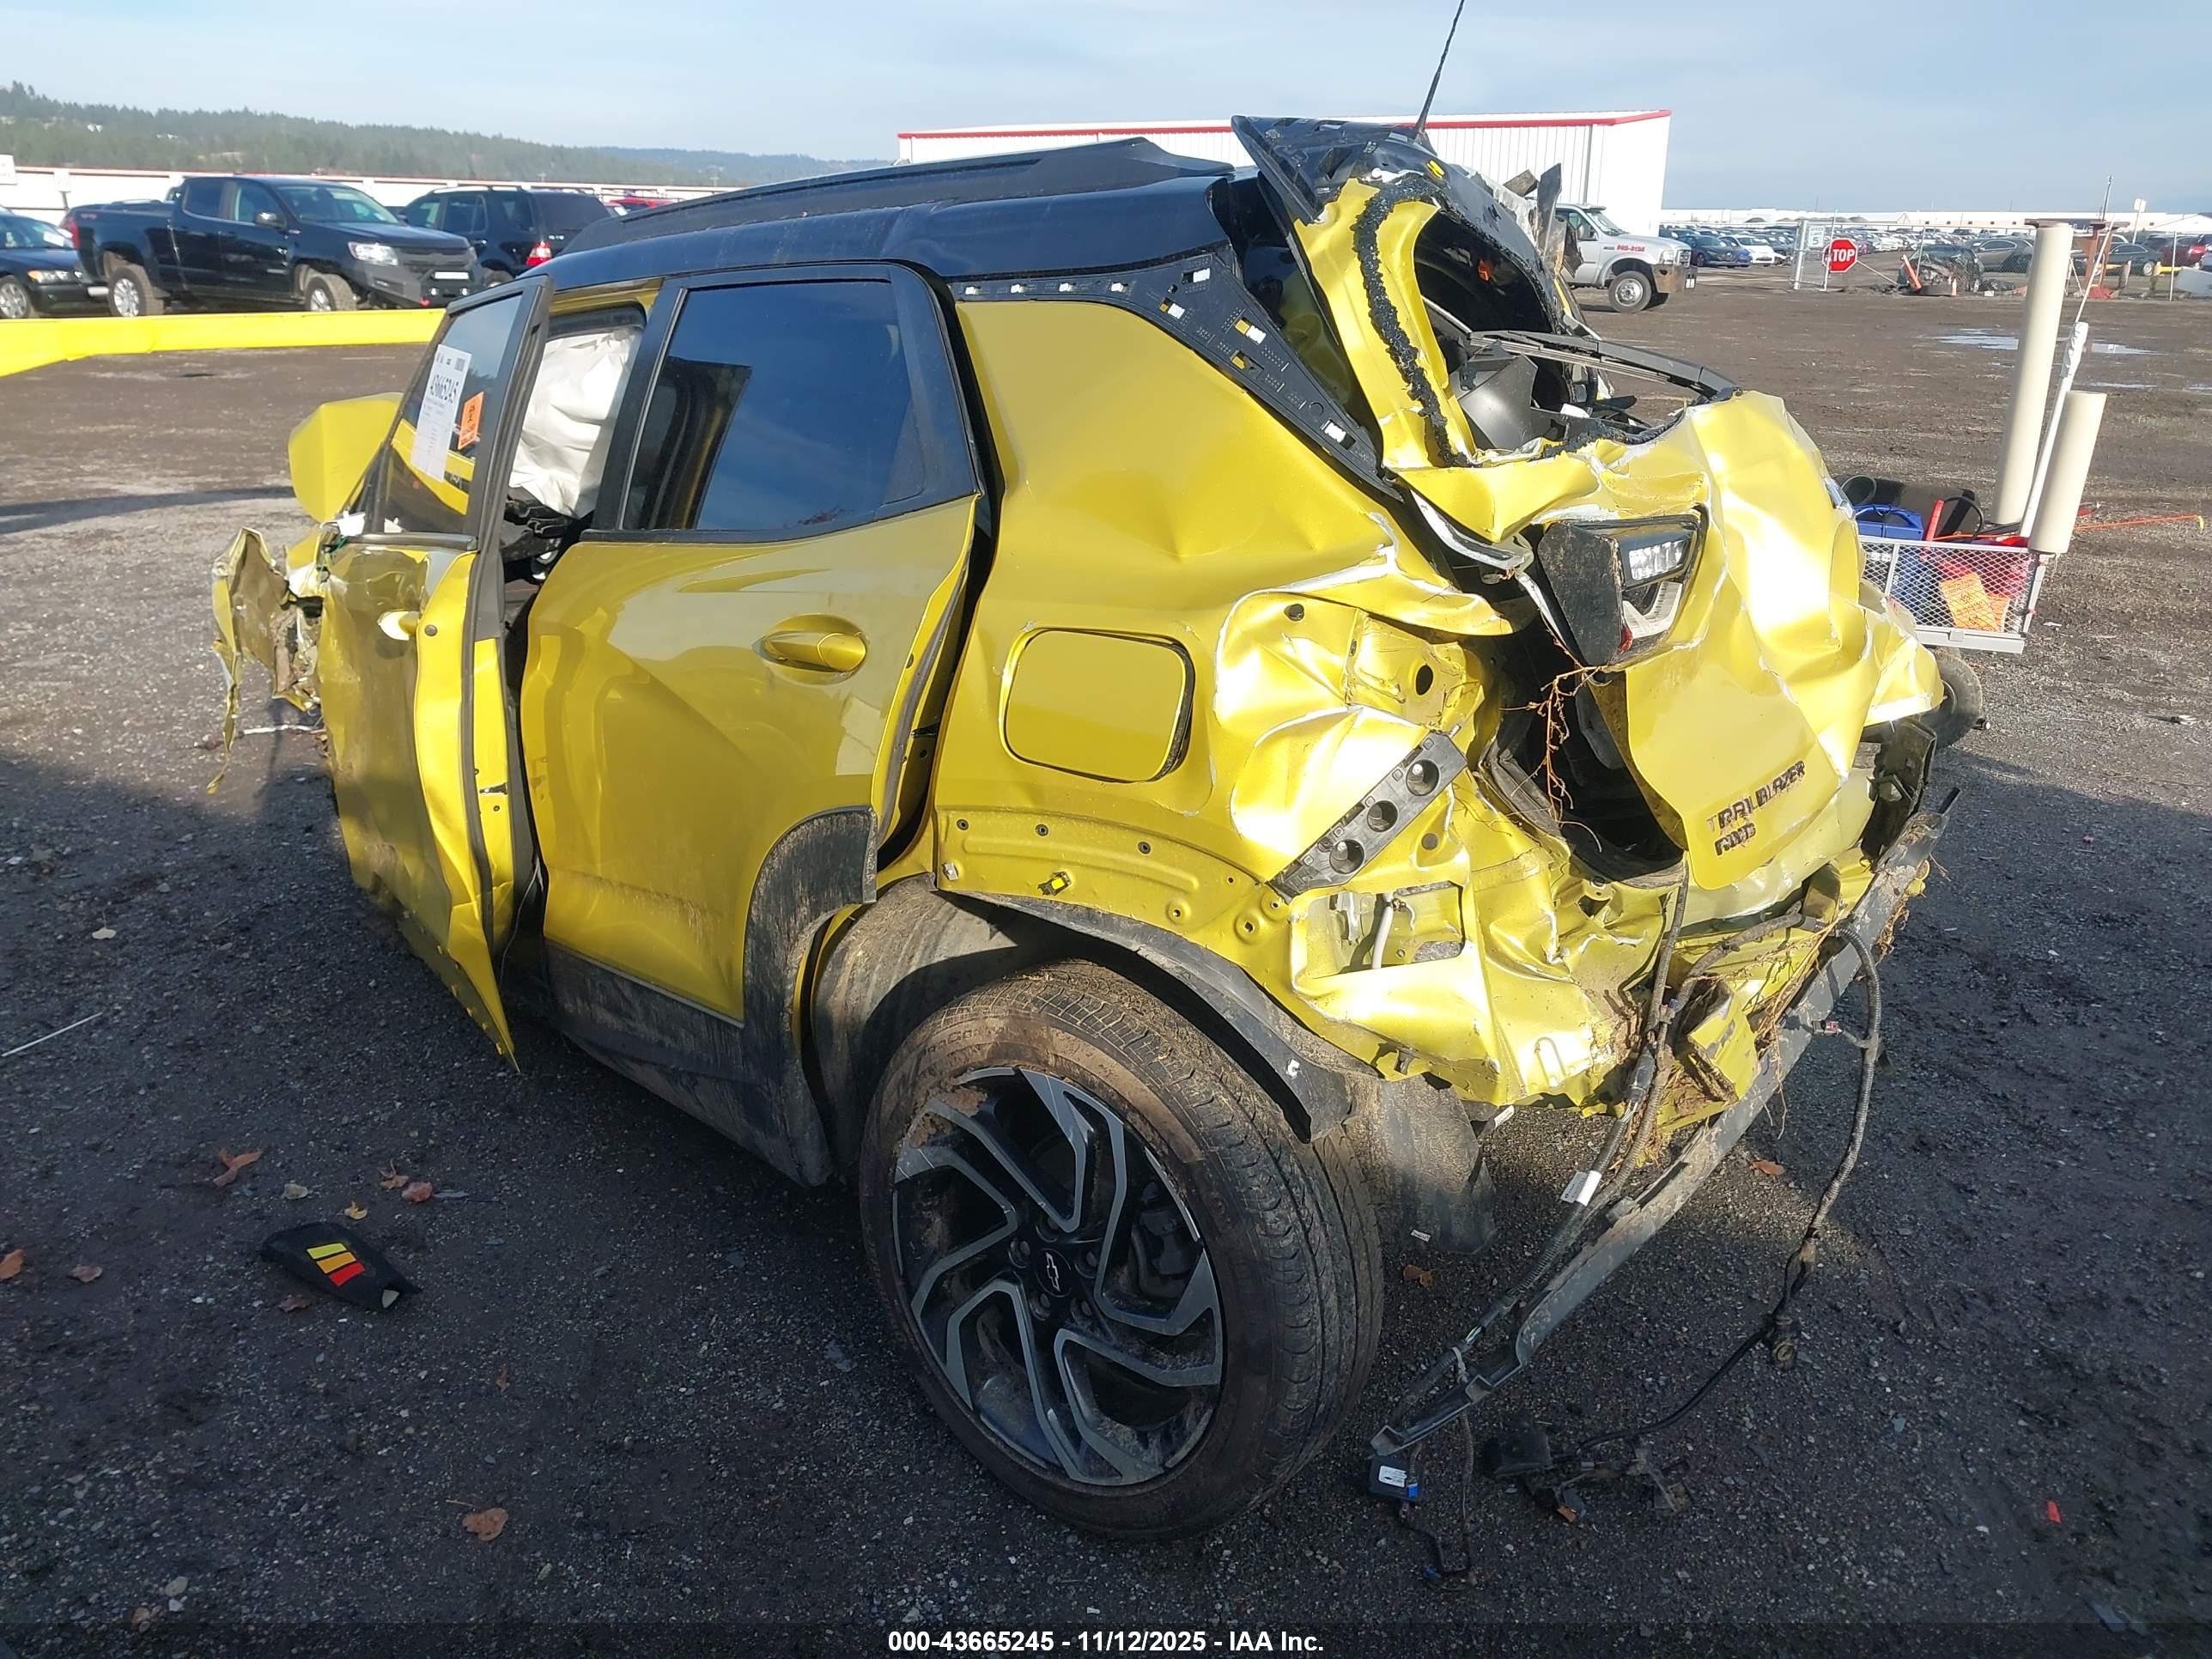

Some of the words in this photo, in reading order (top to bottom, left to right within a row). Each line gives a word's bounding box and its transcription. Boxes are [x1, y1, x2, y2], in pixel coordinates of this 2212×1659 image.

[1812, 236, 1820, 246] 5
[1826, 248, 1856, 263] TOP
[1707, 760, 1806, 831] TRAILBLAZER
